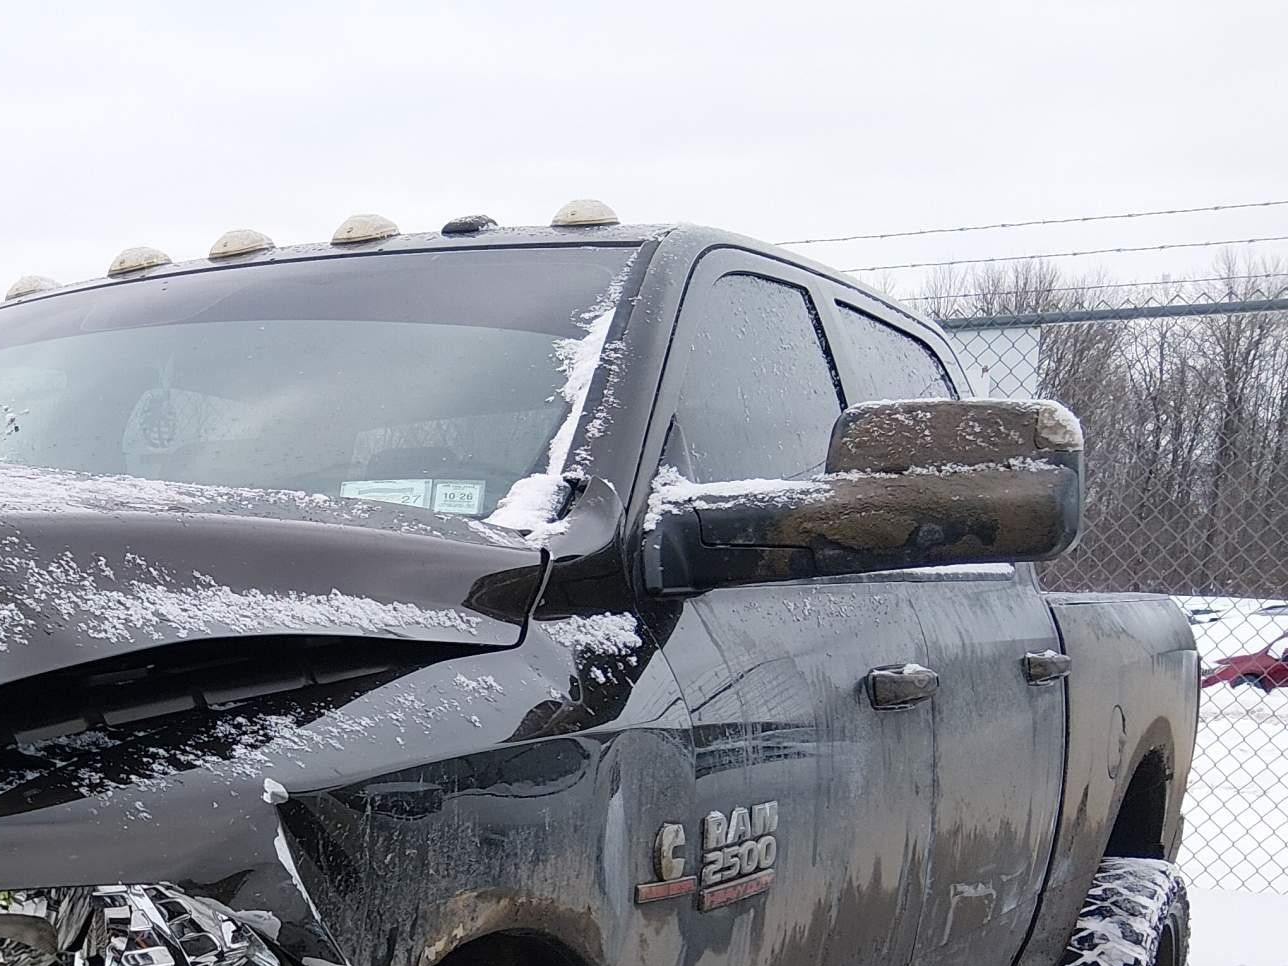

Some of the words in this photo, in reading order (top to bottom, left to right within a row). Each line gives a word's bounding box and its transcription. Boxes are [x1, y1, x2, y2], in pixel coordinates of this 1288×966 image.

[401, 494, 421, 505] 27
[703, 800, 778, 849] RAM
[702, 835, 777, 887] 2500
